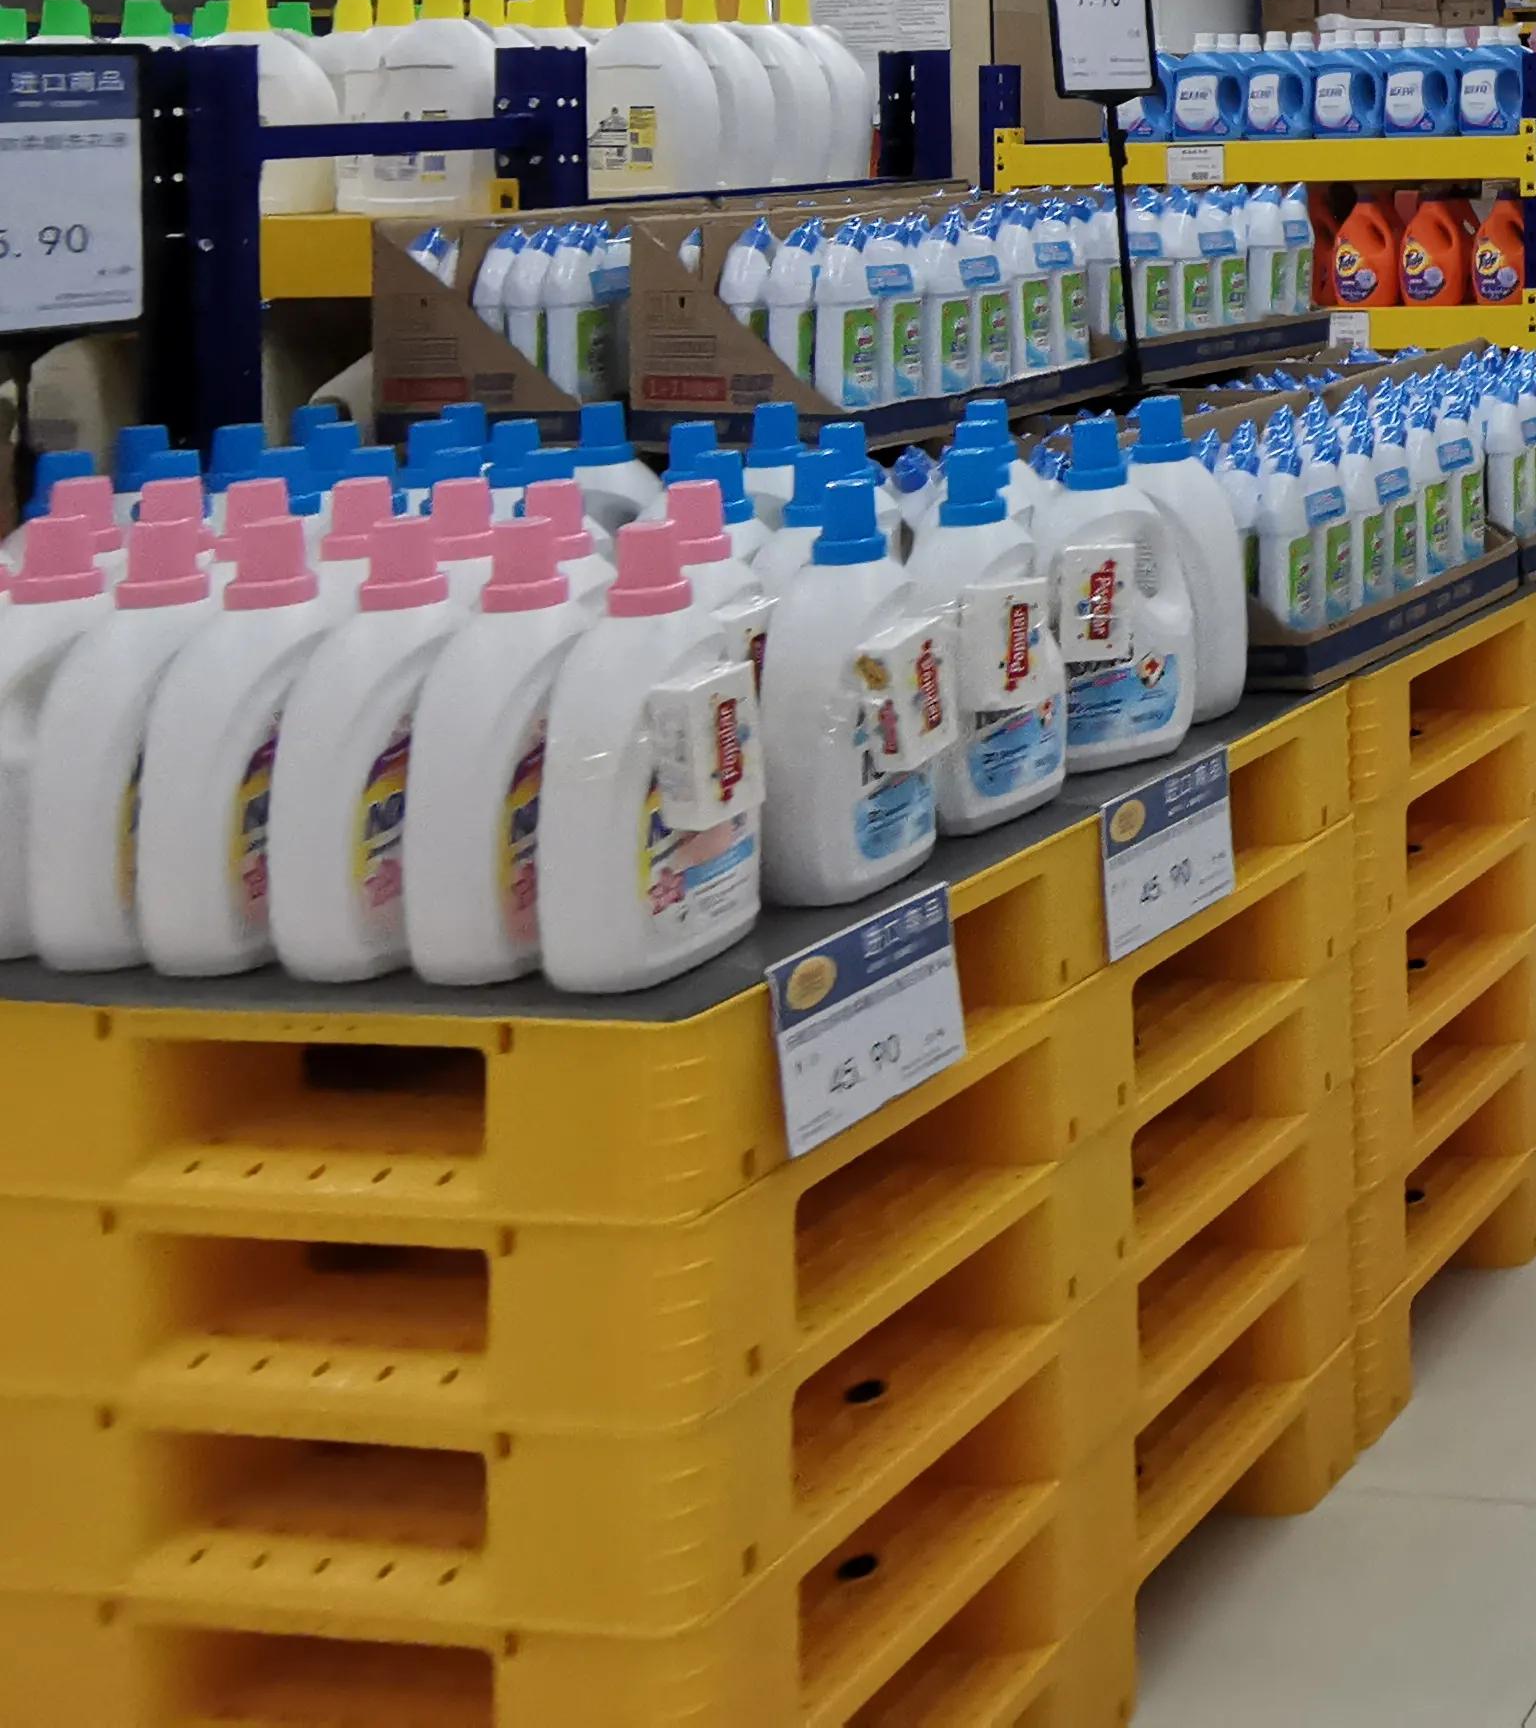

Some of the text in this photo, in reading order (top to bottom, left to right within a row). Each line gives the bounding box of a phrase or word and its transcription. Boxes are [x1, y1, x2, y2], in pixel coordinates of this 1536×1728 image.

[10, 70, 125, 94] 进口商品
[1008, 606, 1028, 676] Popular
